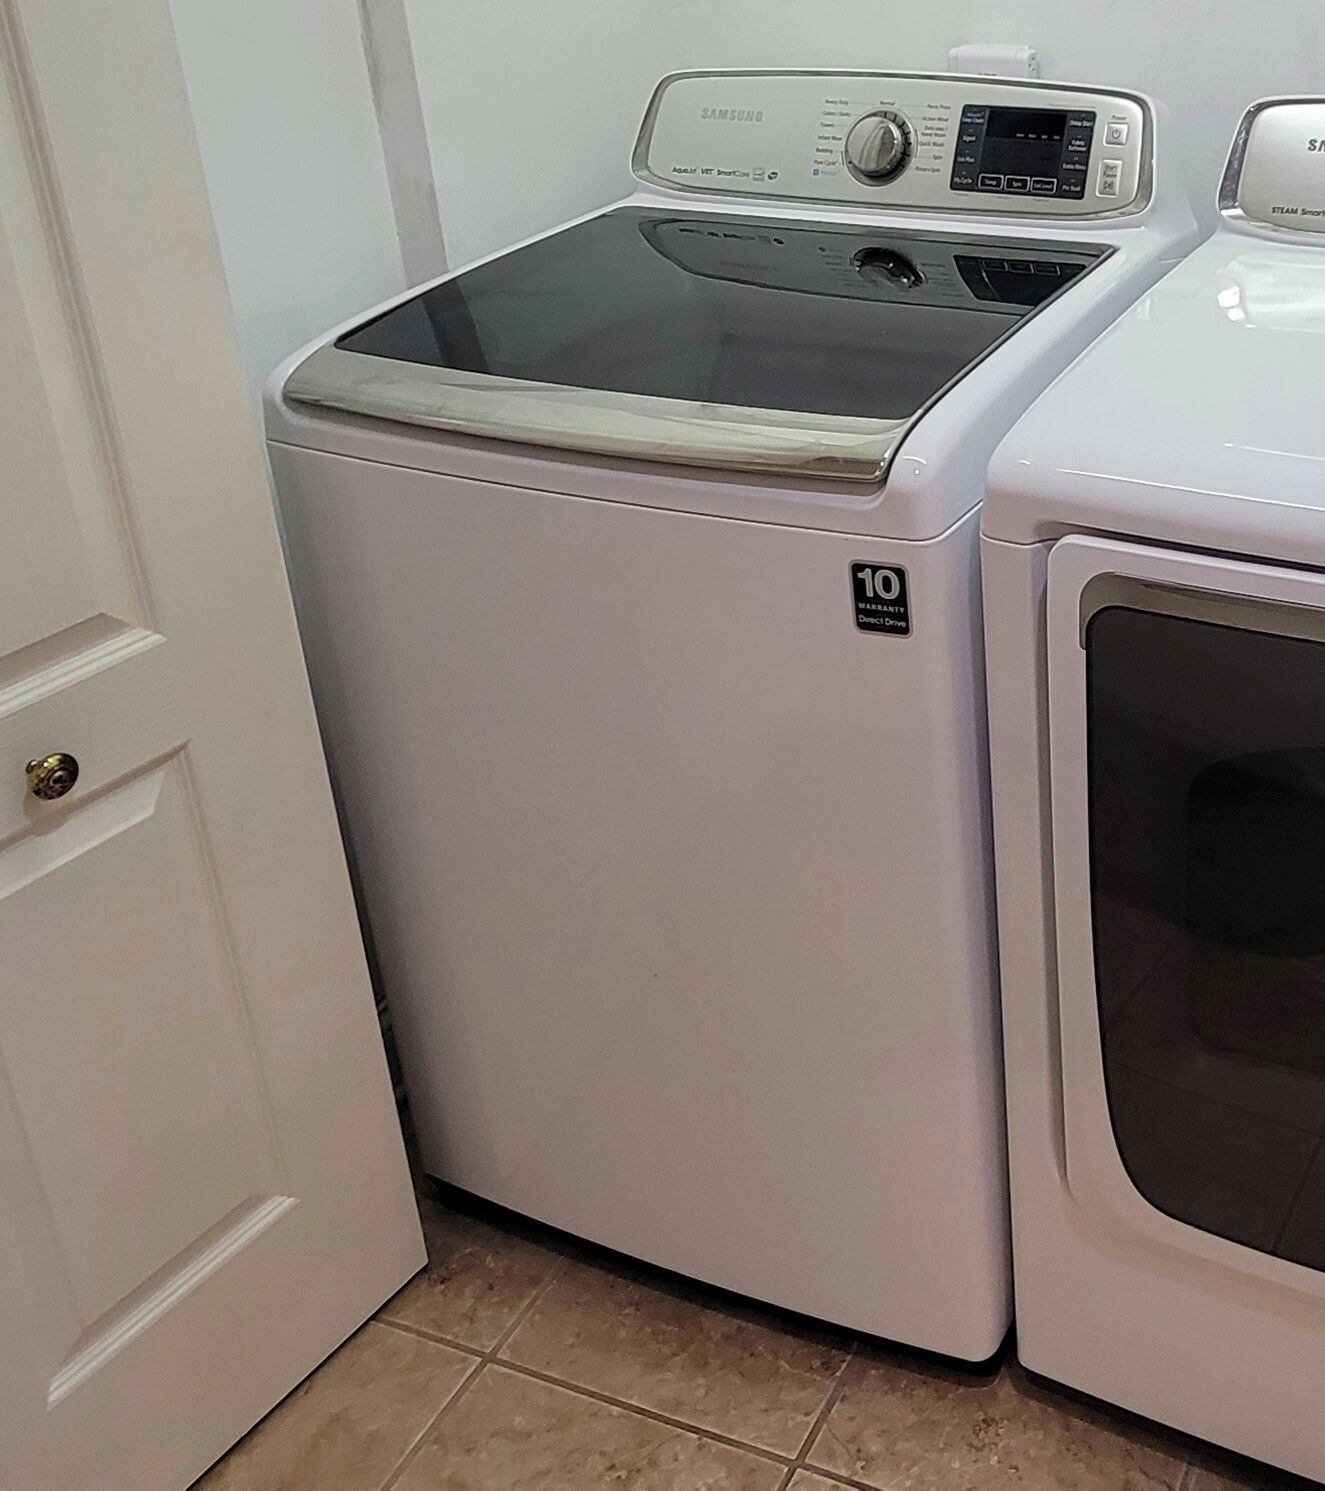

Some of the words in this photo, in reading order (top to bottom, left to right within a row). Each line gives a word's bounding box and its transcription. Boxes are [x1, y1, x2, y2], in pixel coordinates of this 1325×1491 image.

[701, 108, 763, 122] SAMSUNG
[857, 568, 900, 599] 10
[858, 603, 904, 613] WARRANTY
[859, 615, 883, 624] Direct
[885, 618, 906, 628] Drive
